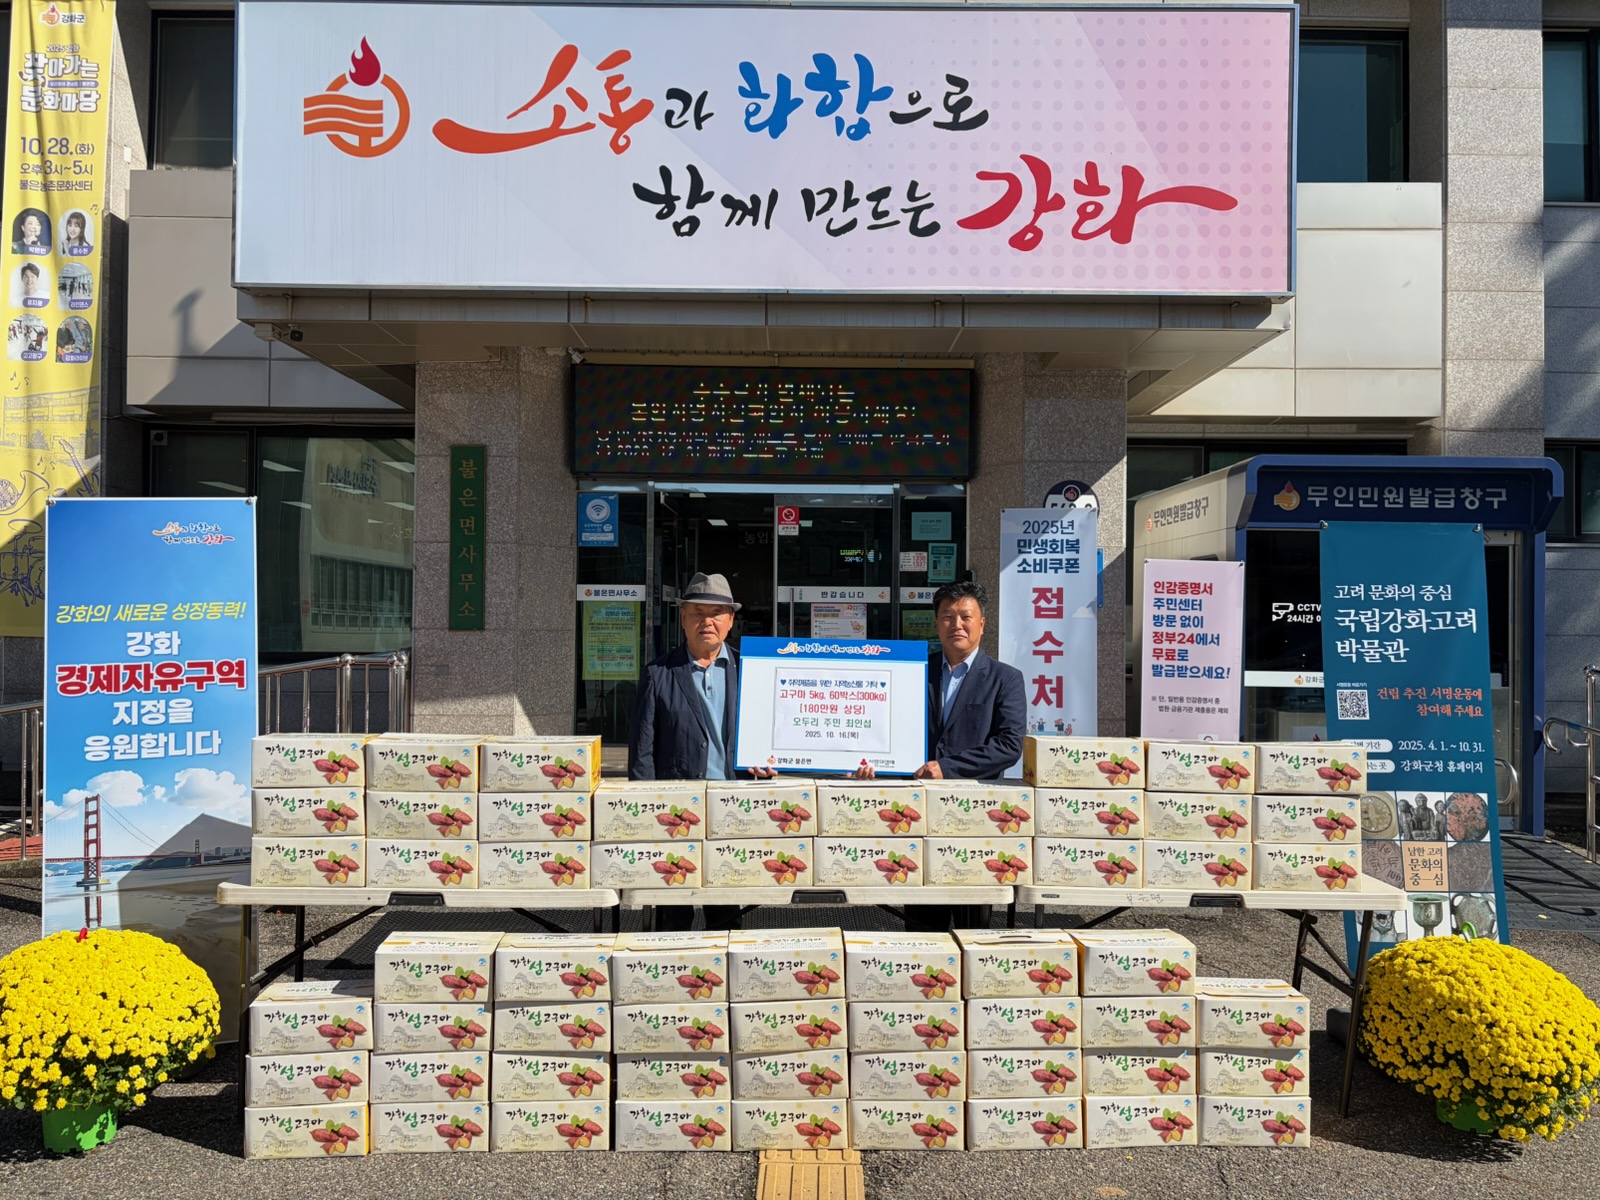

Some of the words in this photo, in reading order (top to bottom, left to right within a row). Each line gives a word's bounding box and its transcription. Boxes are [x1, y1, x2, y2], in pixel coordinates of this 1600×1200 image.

[61, 13, 86, 24] 강화군
[20, 85, 101, 113] 문화마당
[633, 164, 776, 237] 함께
[801, 179, 941, 237] 만드는
[957, 154, 1238, 251] 강화
[1306, 485, 1508, 509] 무인민원발급창구
[1152, 497, 1210, 529] 무인민원발급창구
[1022, 519, 1075, 536] 2025년
[1017, 538, 1081, 555] 민생회복
[1017, 557, 1081, 574] 소비쿠폰
[593, 588, 638, 597] 불은면사무소
[1153, 581, 1213, 596] 인감증명서
[1333, 584, 1365, 601] 고려
[1368, 584, 1416, 601] 문화의
[1419, 584, 1452, 601] 중심
[1153, 597, 1203, 612] 주민센터
[1297, 604, 1322, 612] CCTV
[56, 604, 110, 624] 강화의
[113, 602, 168, 622] 새로운
[171, 601, 247, 621] 성장동력!
[1287, 614, 1314, 623] 24시간
[1152, 614, 1177, 628] 방문
[1180, 615, 1204, 629] 없이
[1334, 608, 1477, 634] 국립강화고려
[126, 631, 181, 657] 강화
[1152, 632, 1221, 646] 정부24에서
[1152, 648, 1189, 662] 무료로
[1335, 638, 1409, 664] 박물관
[56, 658, 247, 696] 경제자유구역
[1151, 664, 1231, 680] 발급받으세요!
[819, 679, 832, 687] 위한
[780, 690, 806, 699] 고구마
[1376, 687, 1399, 700] 건립
[1403, 687, 1427, 700] 추진
[1430, 687, 1482, 701] 서명운동에
[112, 698, 194, 726] 지정을
[1417, 704, 1452, 717] 참여해
[1454, 704, 1484, 718] 주세요
[793, 717, 819, 727] 오두리
[824, 718, 841, 728] 주민
[845, 719, 872, 729] 최인섭
[83, 730, 222, 761] 응원합니다
[1400, 760, 1443, 772] 강화군청
[1447, 760, 1483, 773] 홈페이지
[1407, 847, 1426, 857] 남한
[1427, 847, 1443, 857] 고려
[1408, 858, 1443, 872] 문화의
